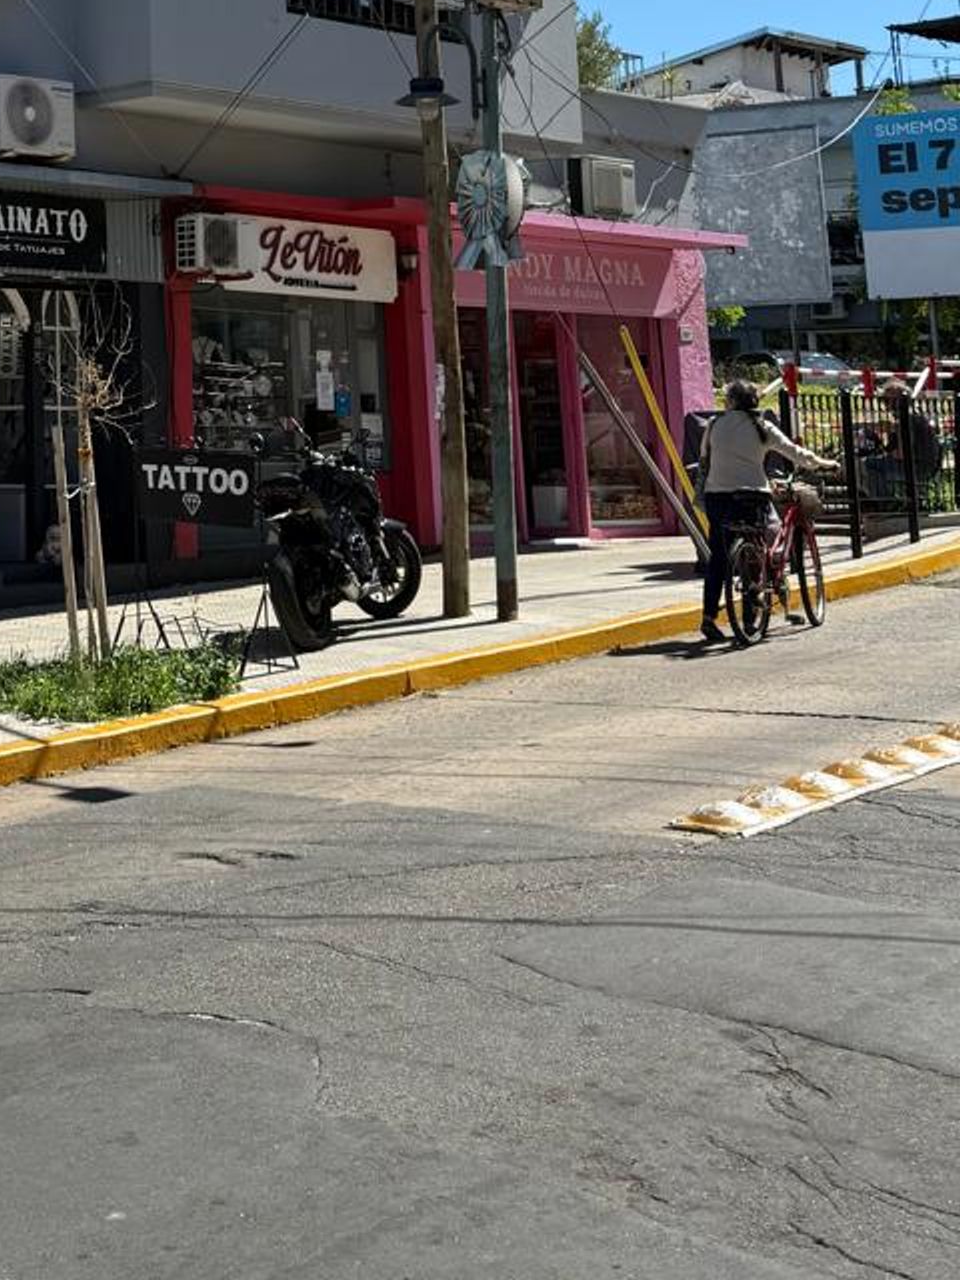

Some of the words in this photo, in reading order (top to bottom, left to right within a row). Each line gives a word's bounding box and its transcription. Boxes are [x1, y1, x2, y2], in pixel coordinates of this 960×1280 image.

[875, 118, 959, 138] SUMEMOS
[878, 141, 919, 175] El
[928, 138, 956, 171] 7
[508, 252, 555, 280] NDY
[563, 255, 645, 287] MAGNA
[141, 464, 249, 495] TATTOO
